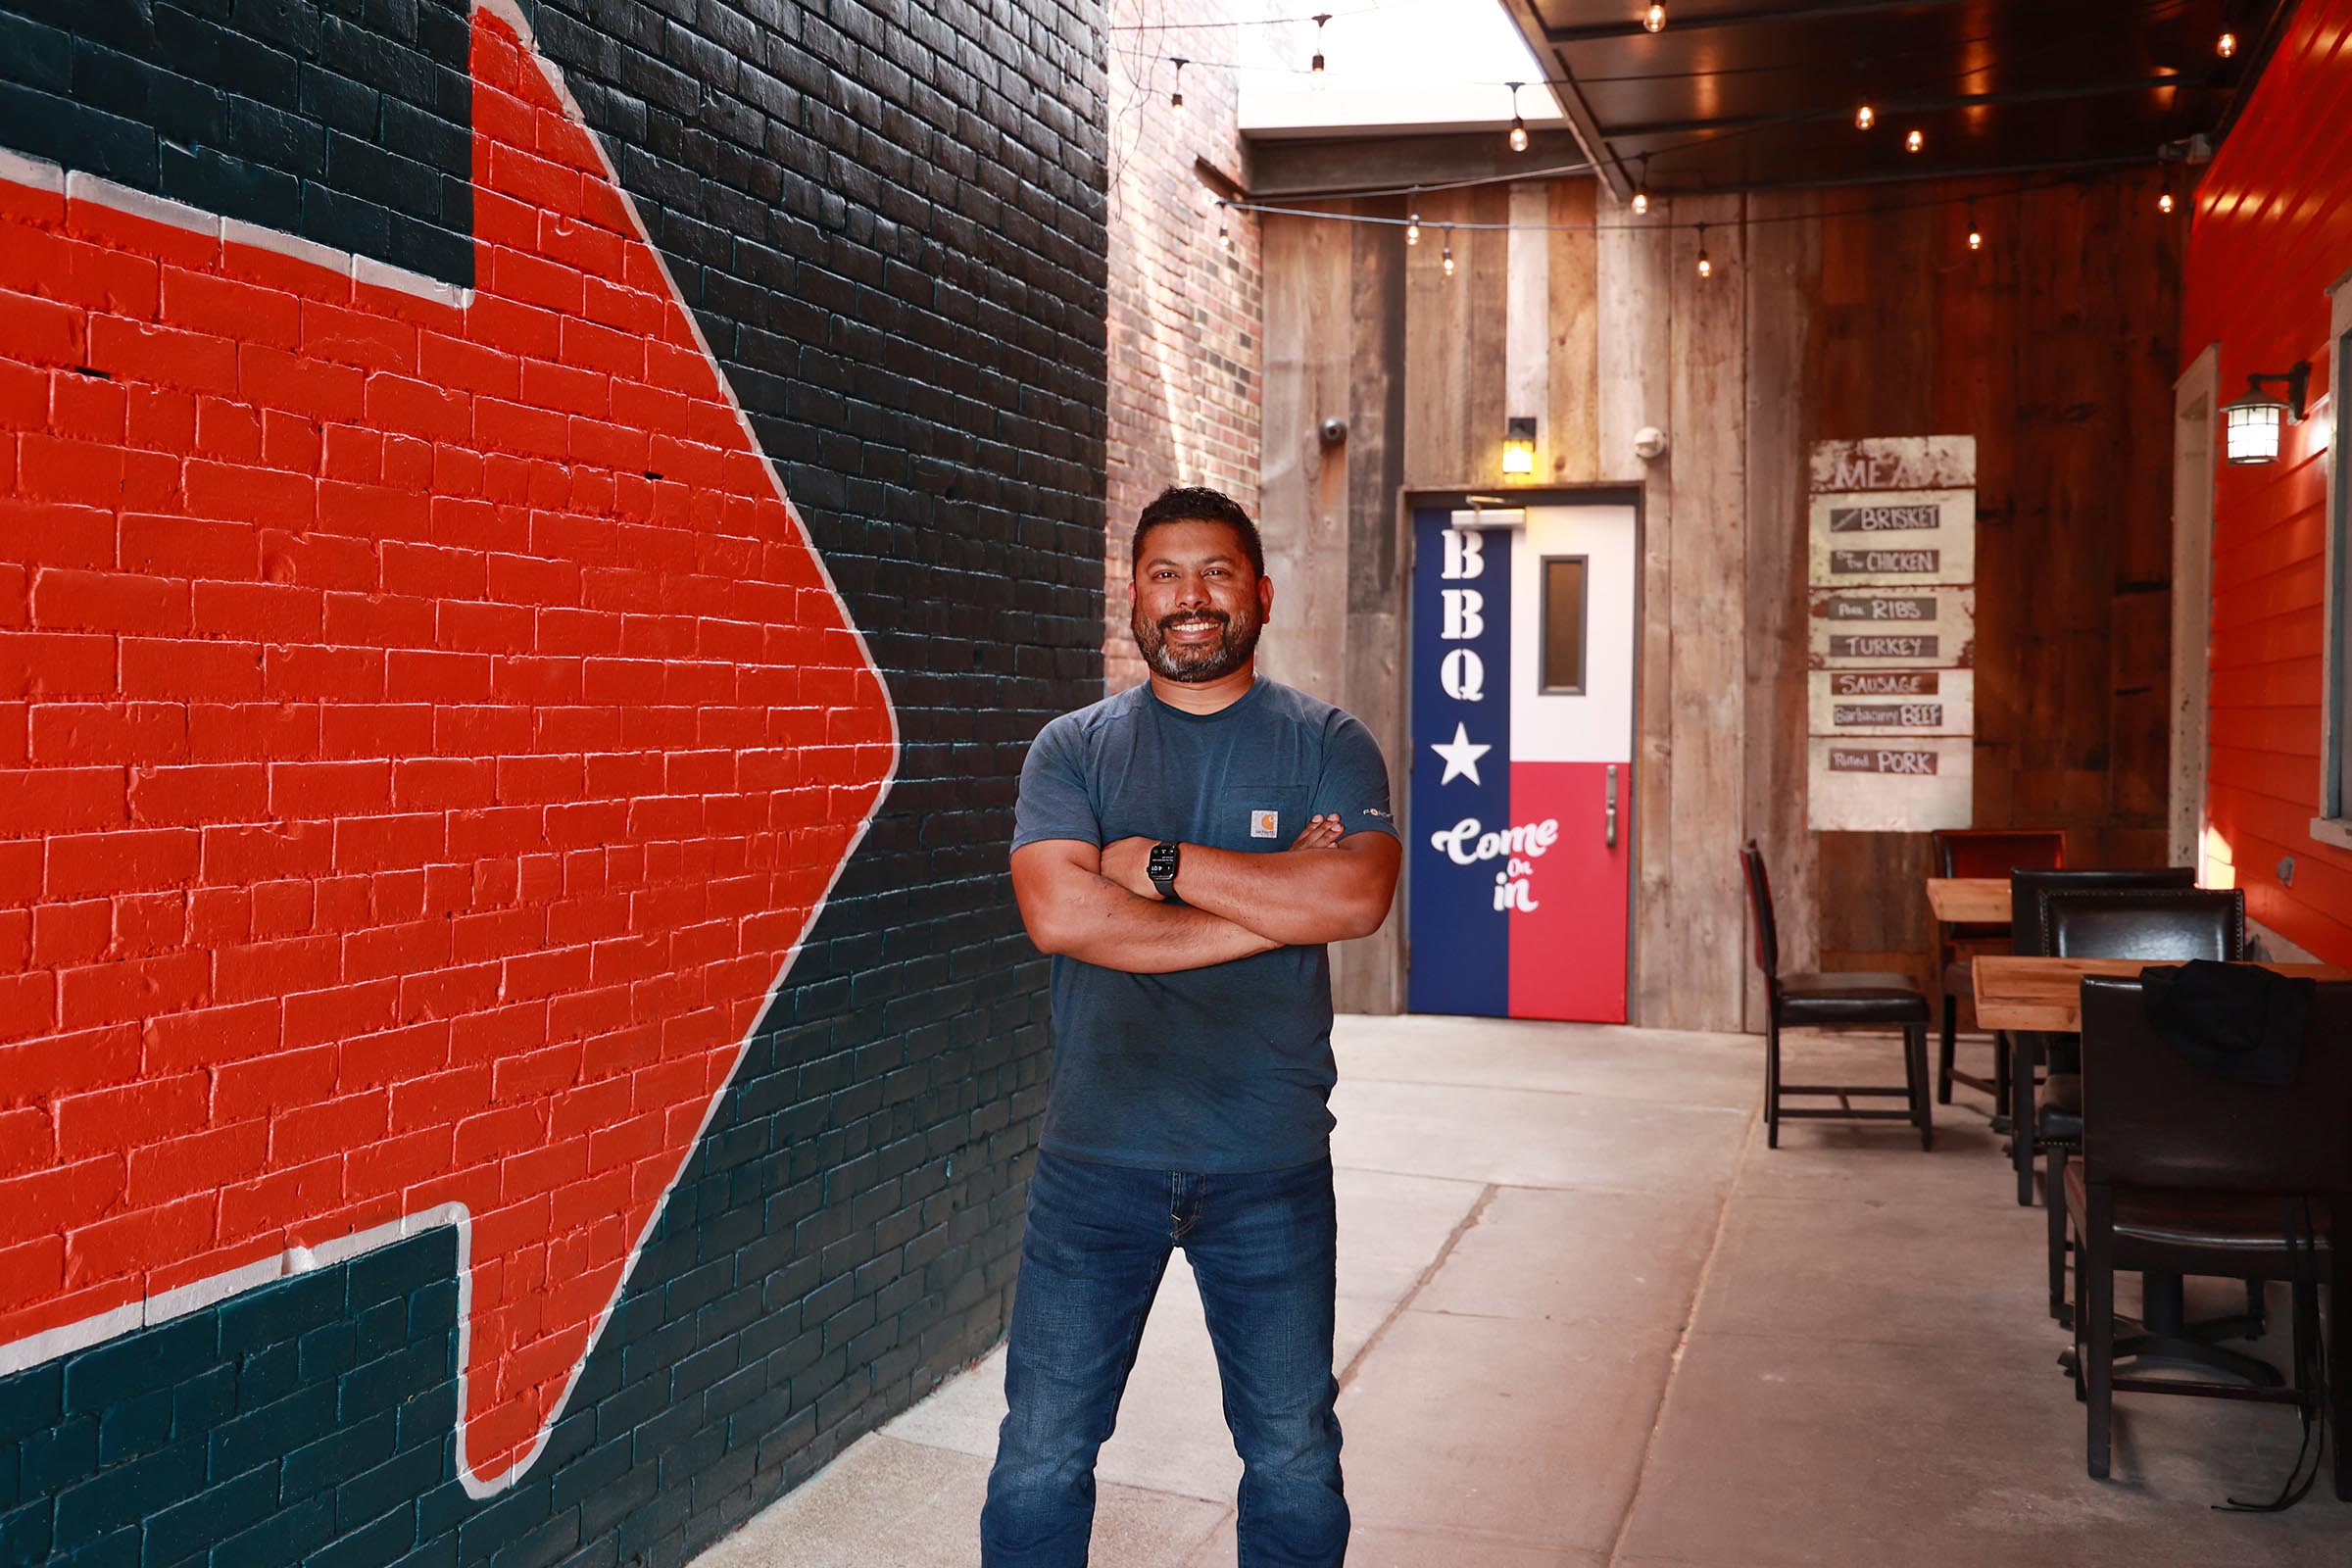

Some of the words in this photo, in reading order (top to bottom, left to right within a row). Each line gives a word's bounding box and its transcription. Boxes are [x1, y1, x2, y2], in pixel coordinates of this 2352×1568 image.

[1861, 506, 1936, 530] BRISKET
[1866, 551, 1934, 571] CHICKEN
[1441, 529, 1485, 702] BBQ
[1872, 600, 1921, 619] RIBS
[1845, 637, 1922, 656] TURKEY
[1838, 674, 1922, 694] SAUSAGE
[1900, 705, 1941, 725] BEEF
[1878, 751, 1933, 774] PORK
[1431, 817, 1559, 865] Come
[1507, 858, 1534, 878] On
[1493, 871, 1540, 912] in
